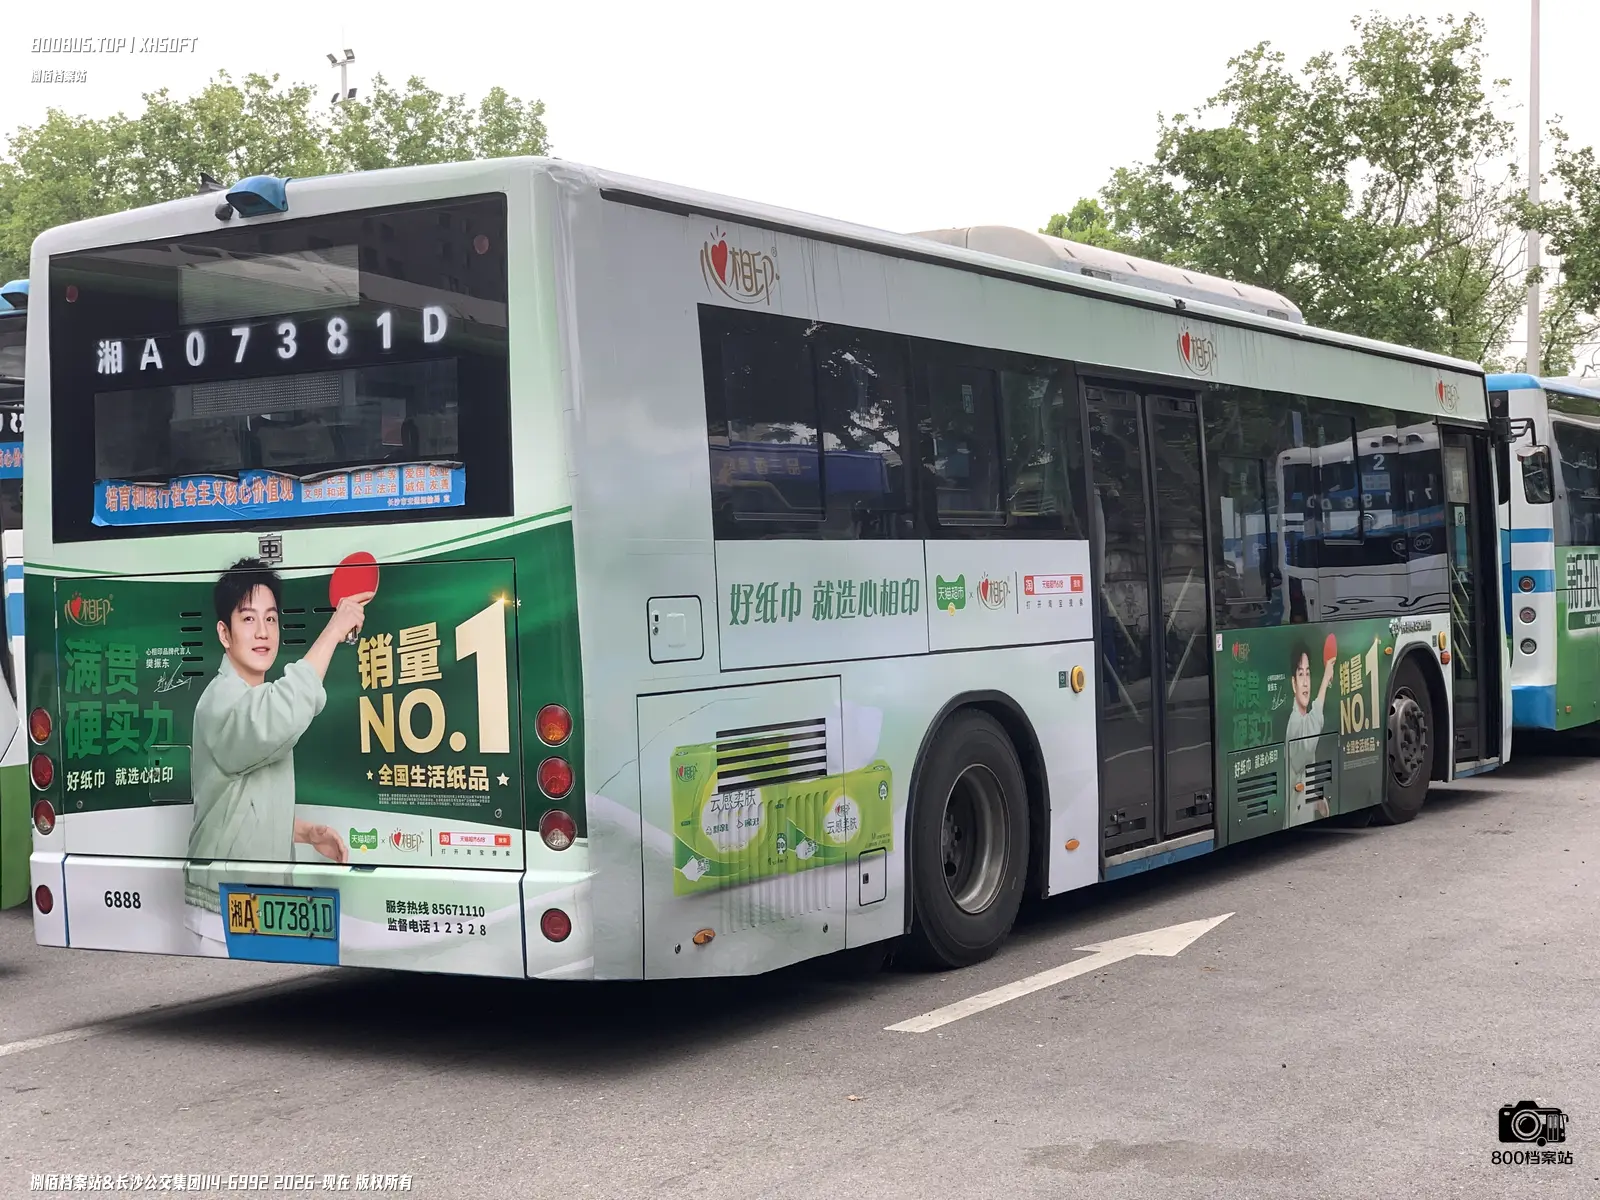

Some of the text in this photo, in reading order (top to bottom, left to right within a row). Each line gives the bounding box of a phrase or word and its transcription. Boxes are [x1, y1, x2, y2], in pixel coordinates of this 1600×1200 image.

[700, 226, 780, 306] 心相印
[353, 467, 397, 483] 自由 平等
[405, 466, 449, 479] 爱国 敬业
[105, 474, 293, 512] 培育和践行社会主义核心价值观
[303, 486, 346, 499] 文明 和谐
[353, 482, 397, 496] 公正 法治
[405, 478, 449, 492] 诚信 友善
[729, 577, 920, 626] 好纸巾 就选心相印
[938, 586, 964, 600] 天猫超市
[64, 593, 114, 626] 心相印
[145, 647, 192, 656] 心相印品牌代言人
[145, 658, 170, 669] 樊振东
[357, 621, 442, 690] 销量
[65, 639, 139, 696] 满贯
[359, 598, 510, 754] NO.1
[1340, 654, 1362, 696] 销量
[1232, 669, 1260, 709] 满贯
[1340, 638, 1380, 735] NO.1
[65, 699, 174, 759] 硬实力
[67, 766, 174, 792] 好纸巾 就选心相印
[378, 763, 490, 791] 全国生活纸品
[710, 788, 757, 812] 云感柔肤
[827, 817, 858, 834] 云感柔肤
[351, 834, 376, 844] 天猫超市
[104, 890, 142, 909] 6888
[386, 900, 485, 917] 服务热线 85671110
[387, 917, 430, 933] 监督电话
